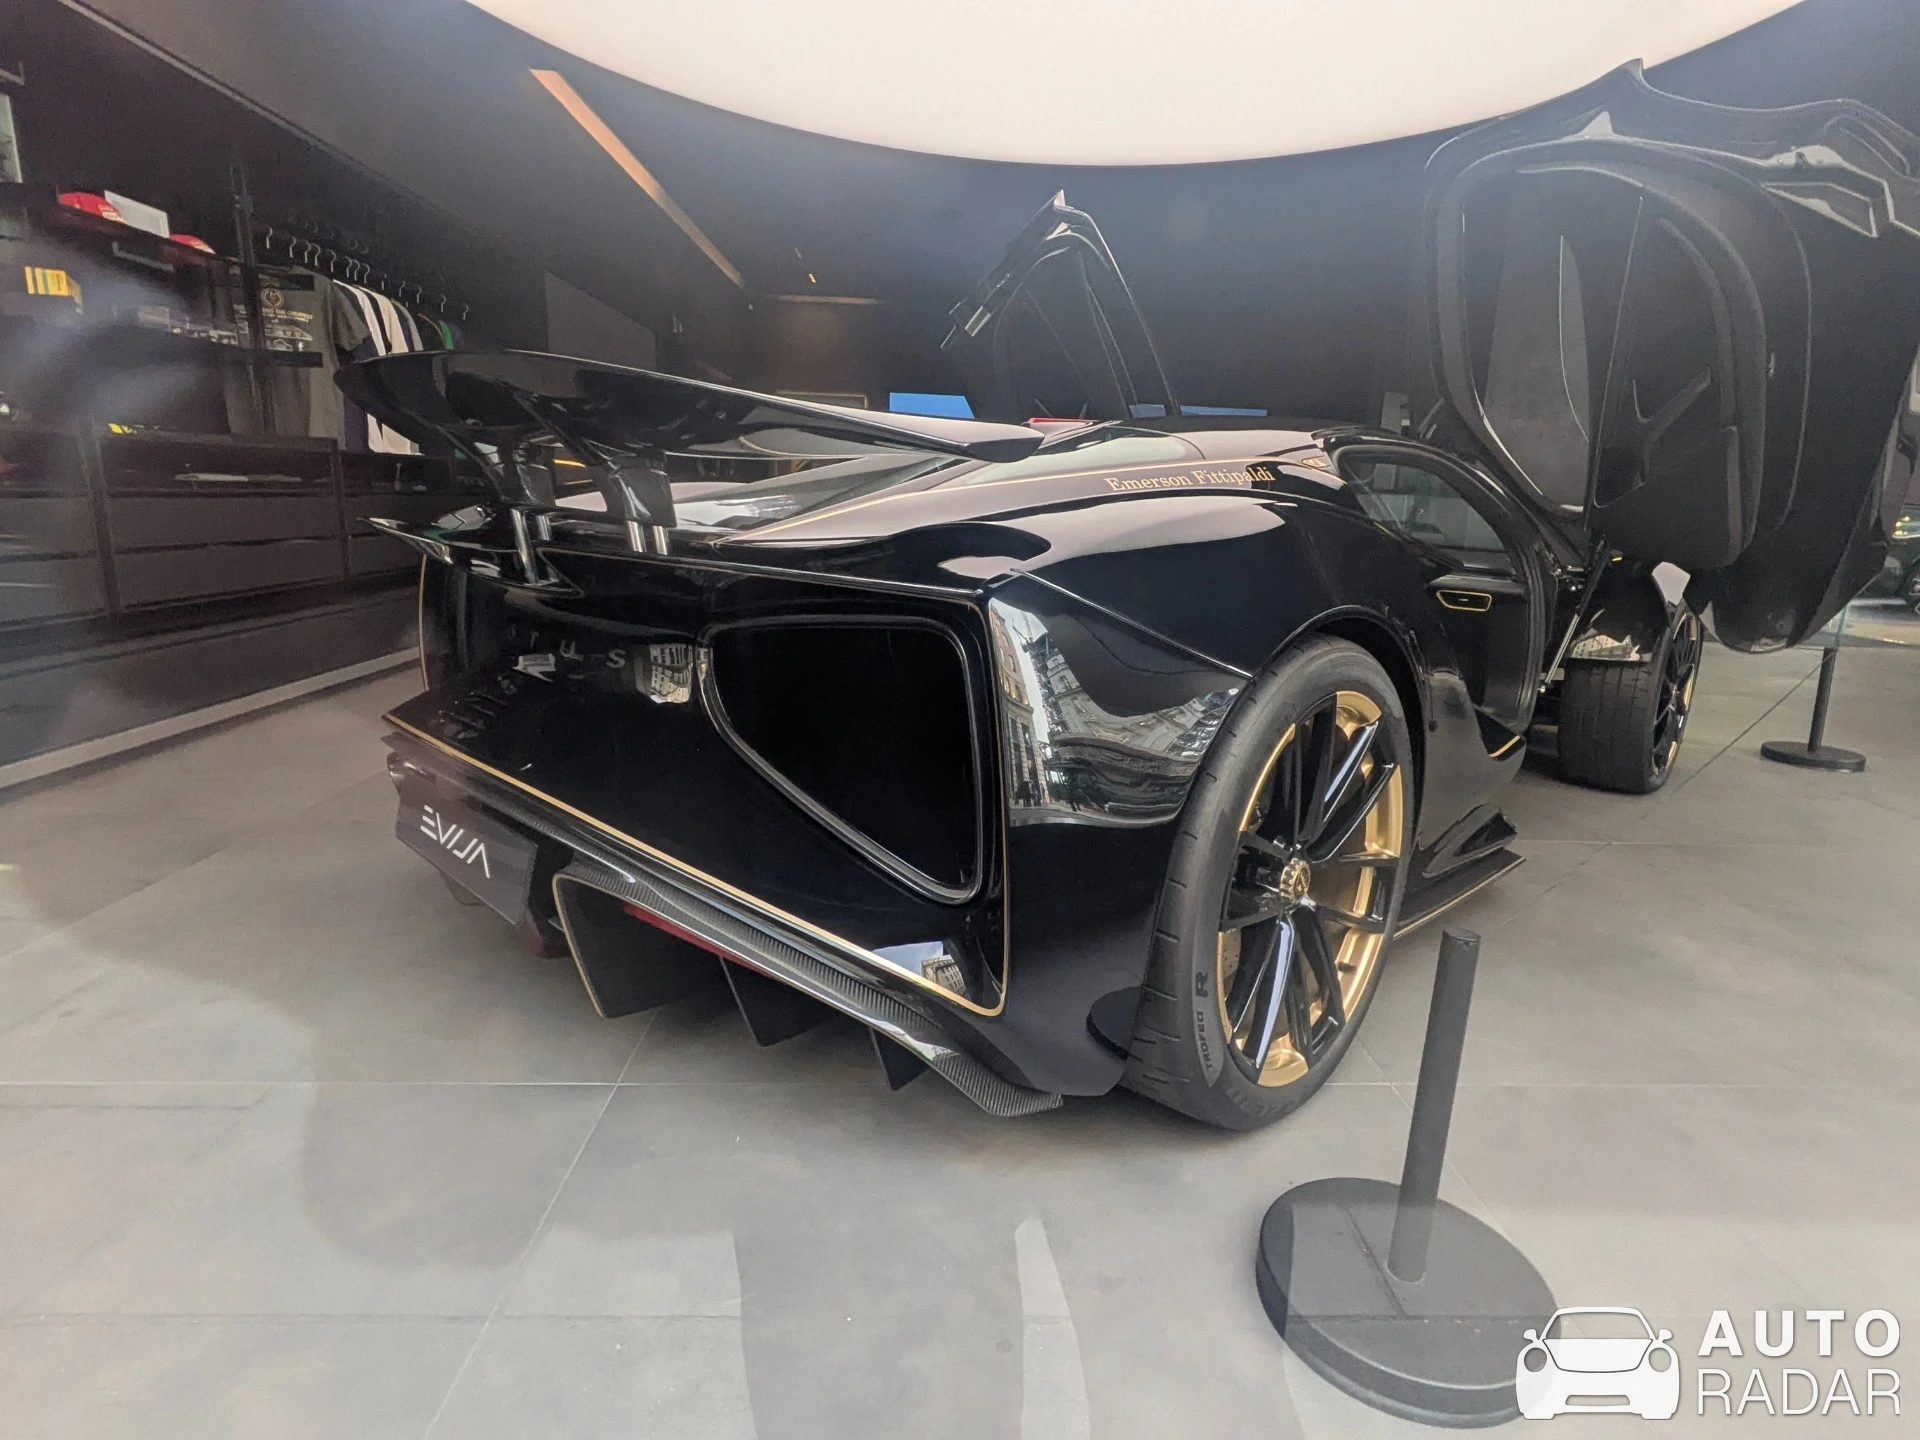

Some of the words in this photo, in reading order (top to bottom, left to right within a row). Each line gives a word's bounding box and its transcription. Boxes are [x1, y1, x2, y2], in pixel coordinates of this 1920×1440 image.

[1104, 474, 1193, 491] Emerson
[1192, 467, 1276, 488] Fittipaldi
[420, 804, 491, 879] EVIJA
[1195, 971, 1208, 998] R
[1195, 1010, 1212, 1069] TROFEO
